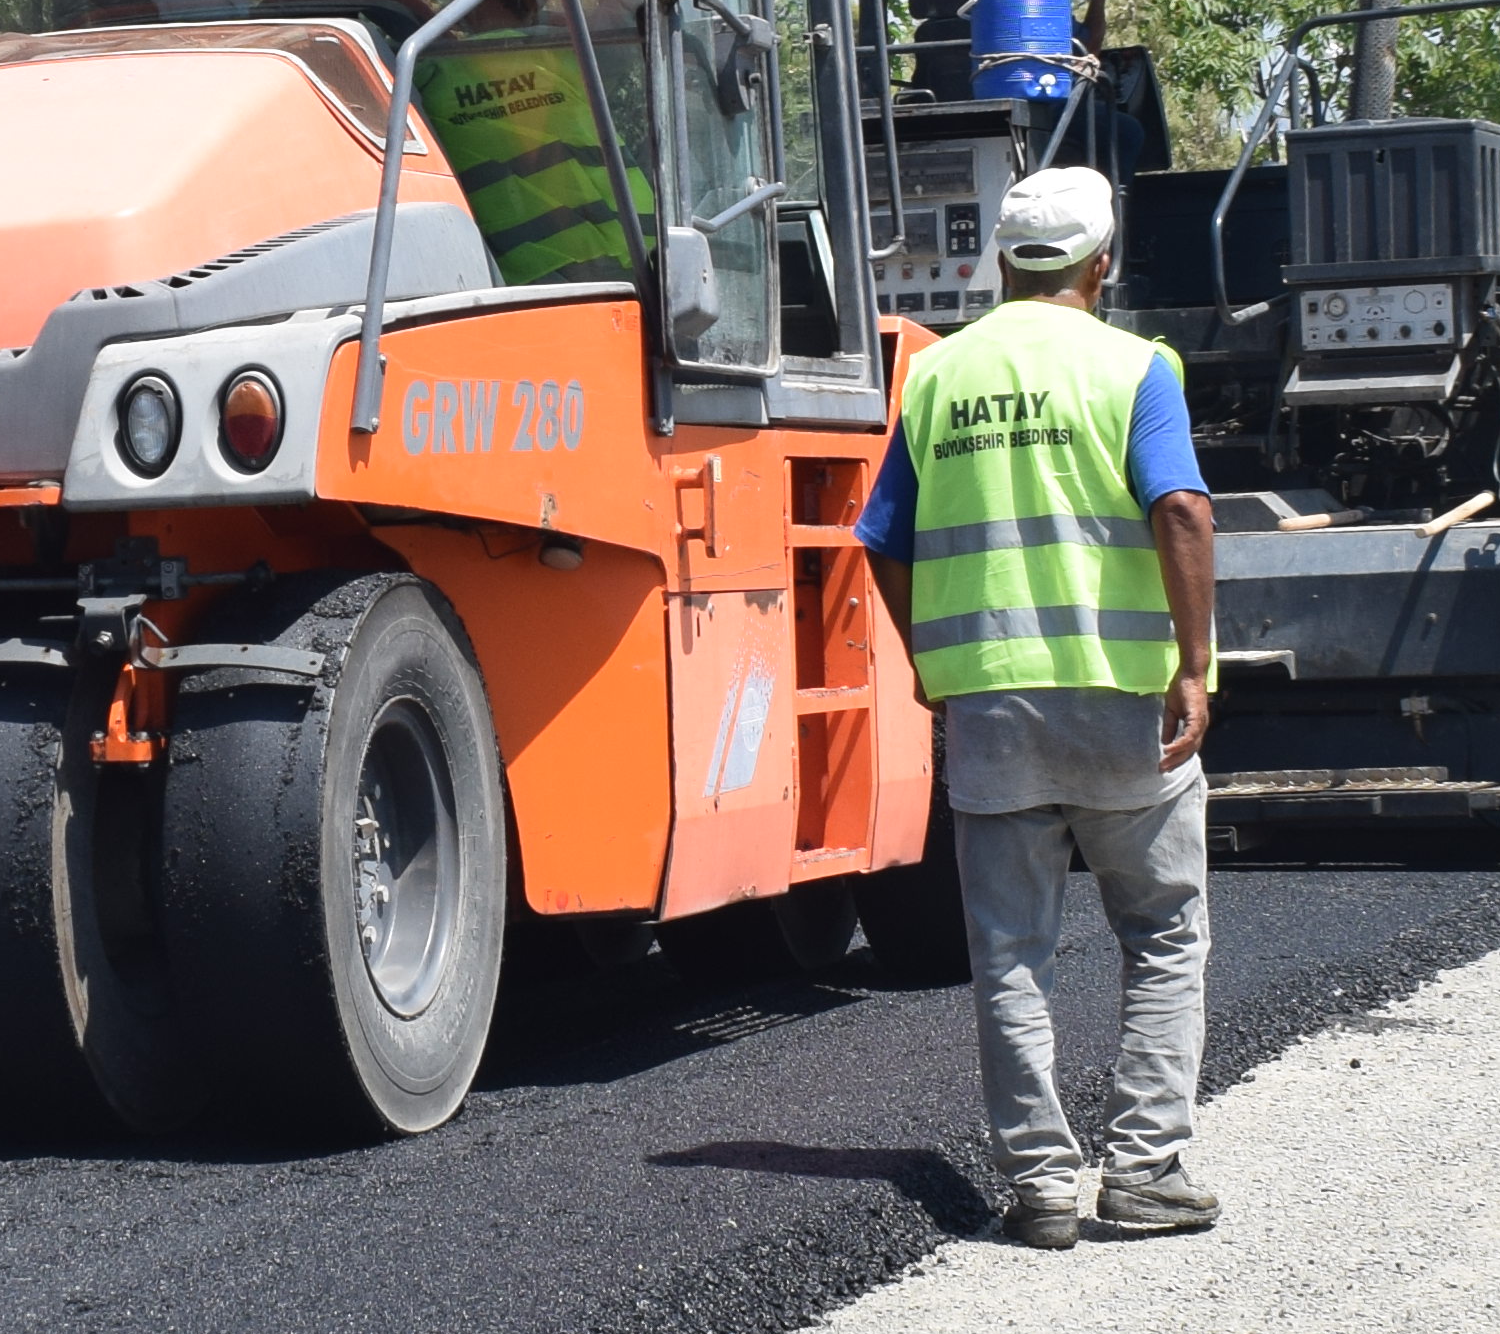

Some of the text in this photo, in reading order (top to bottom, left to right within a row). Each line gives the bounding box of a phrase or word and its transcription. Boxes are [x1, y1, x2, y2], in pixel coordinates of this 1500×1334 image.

[454, 71, 536, 109] HATAY
[402, 379, 585, 455] GRW 280
[951, 391, 1050, 430] HATAY
[933, 429, 1005, 461] BÜYÜKŞEHİR
